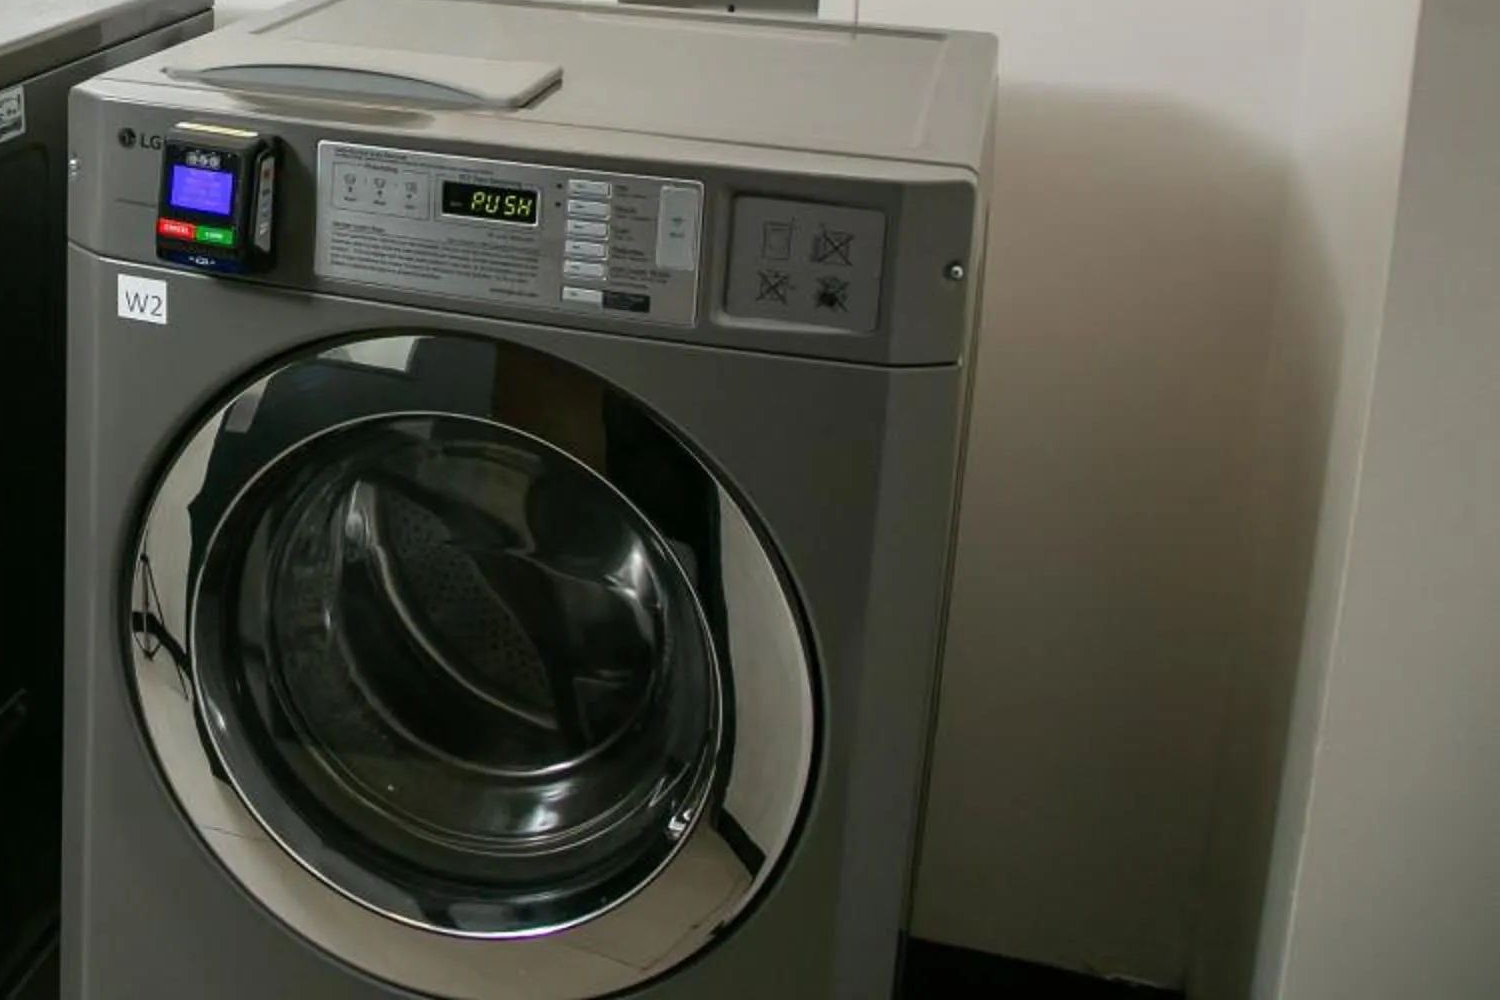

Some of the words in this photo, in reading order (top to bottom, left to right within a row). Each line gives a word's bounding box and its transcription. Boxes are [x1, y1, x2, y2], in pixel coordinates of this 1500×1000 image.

[140, 134, 162, 149] LG
[471, 191, 533, 217] PUSH
[125, 291, 162, 316] W2
